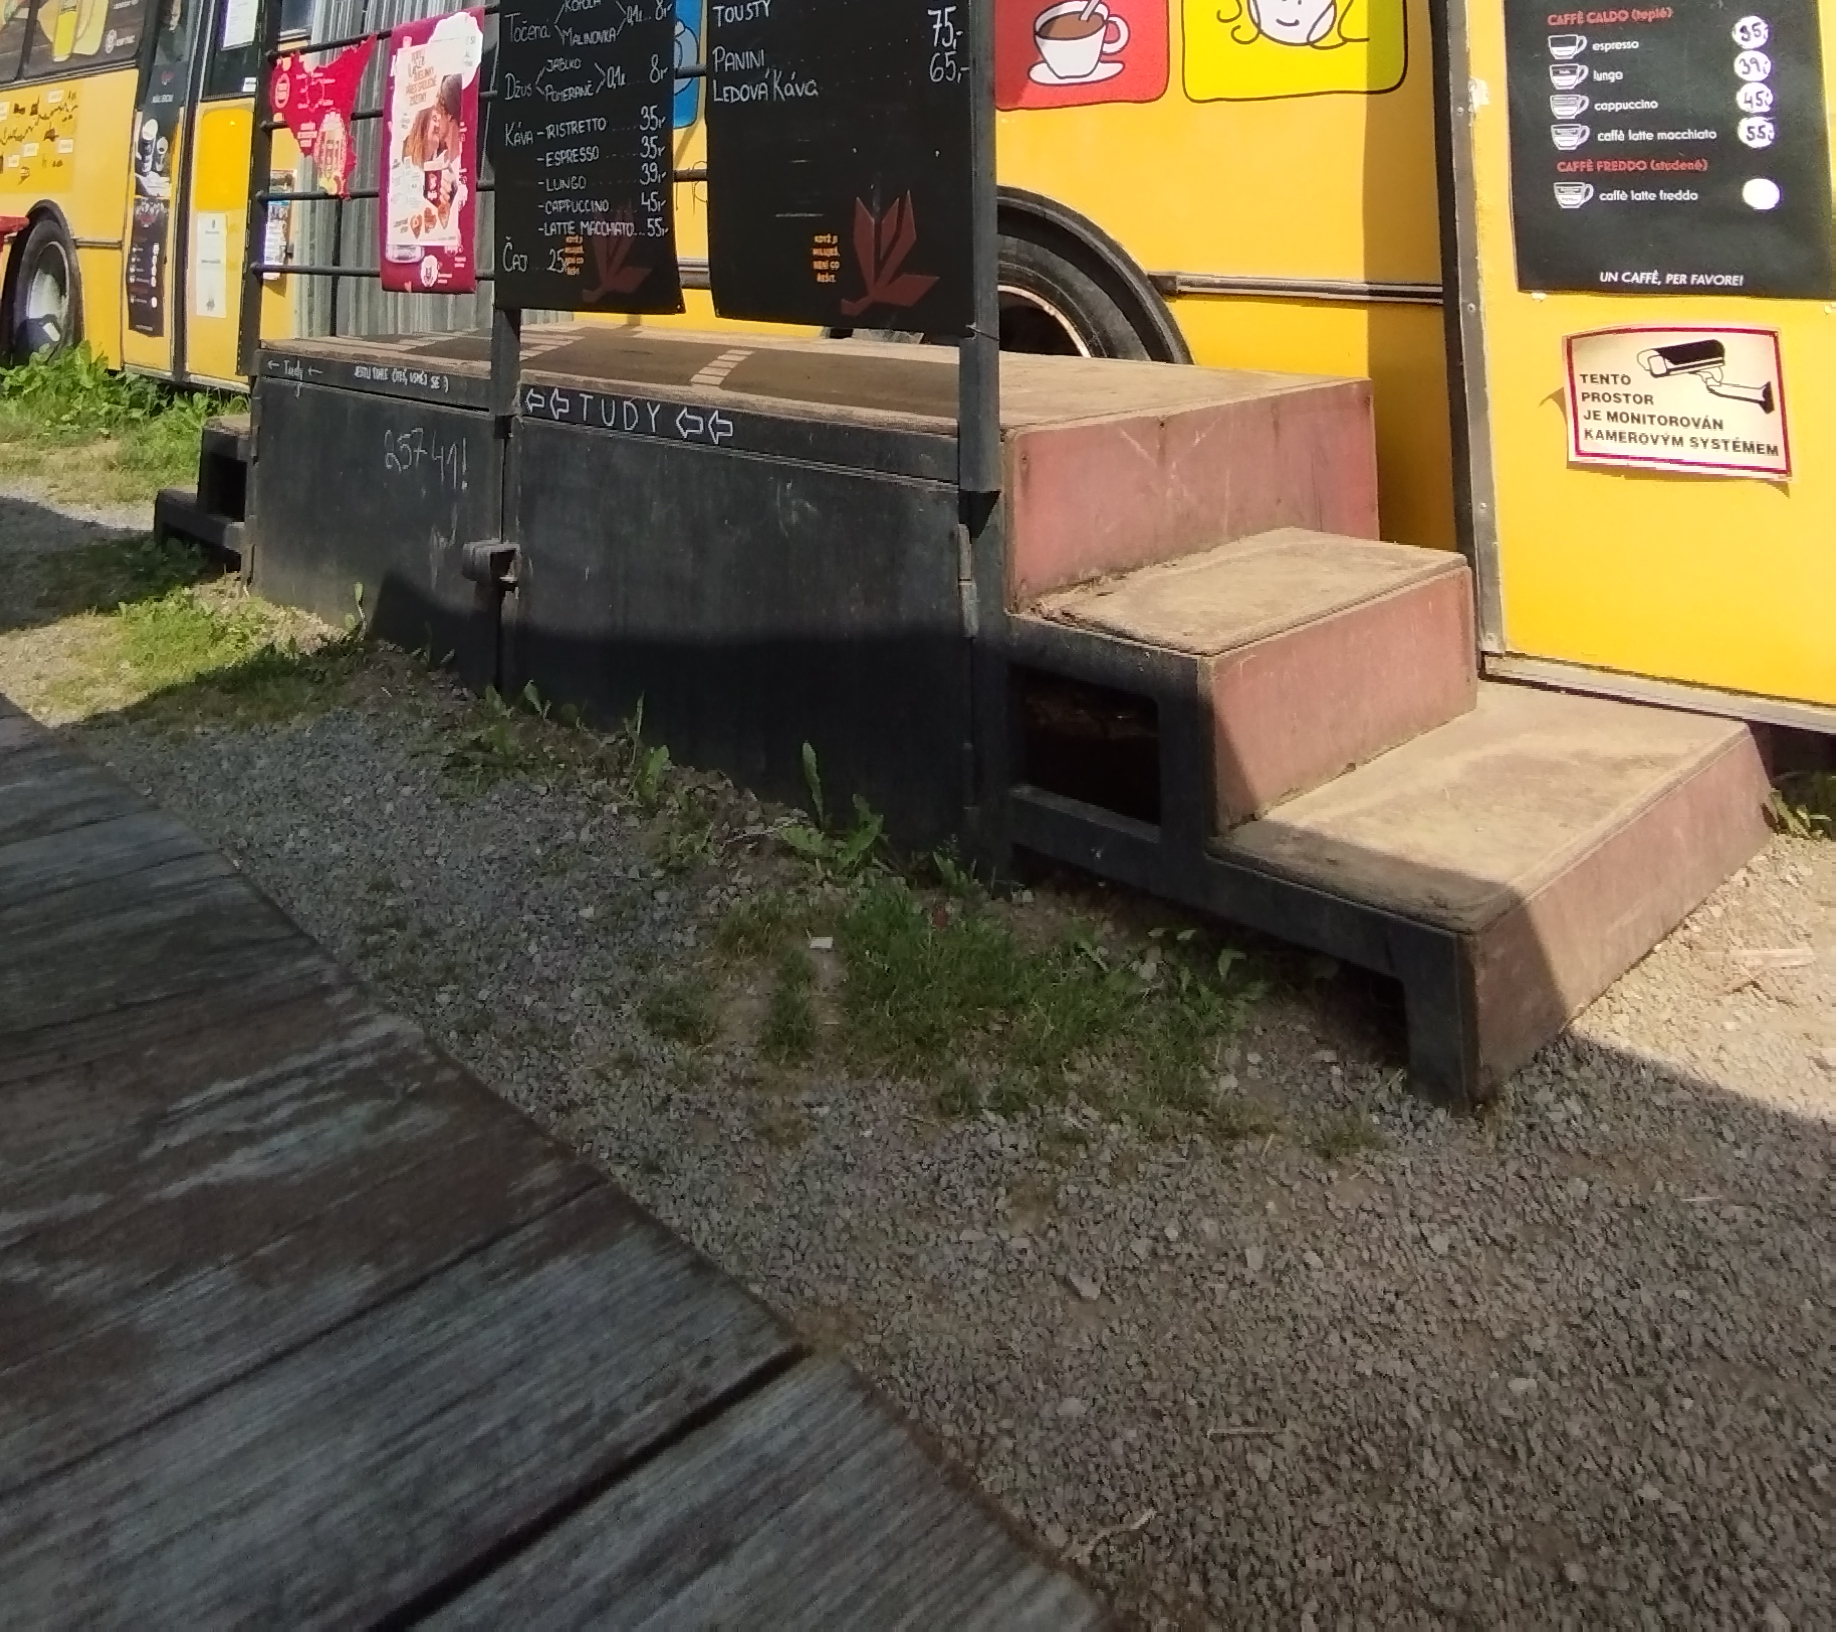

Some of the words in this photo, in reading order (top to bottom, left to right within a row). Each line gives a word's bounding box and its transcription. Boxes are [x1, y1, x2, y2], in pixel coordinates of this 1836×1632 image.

[1547, 11, 1585, 26] CAFFÈ
[1586, 9, 1628, 25] CALDO
[561, 26, 618, 46] MALINOVKA
[1592, 39, 1640, 52] espresso
[712, 46, 765, 72] PANINI
[1593, 70, 1624, 83] lungo
[545, 80, 594, 102] POMERANČ
[713, 68, 769, 103] LEDOVÁ
[1594, 99, 1659, 113] cappuccino
[1597, 129, 1625, 142] caffè
[1628, 129, 1654, 141] latte
[1657, 128, 1717, 141] macchiato
[1556, 158, 1594, 173] CAFFÈ
[1596, 160, 1647, 172] FREDDO
[1599, 189, 1628, 202] caffè
[1630, 189, 1657, 201] latte
[1659, 189, 1698, 202] freddo
[580, 221, 635, 237] MACCHIATO
[1599, 271, 1619, 283] UN
[1621, 269, 1662, 286] CAFFÈ,
[1665, 273, 1687, 286] PER
[1689, 272, 1744, 287] FAVORE!
[1579, 373, 1631, 386] TENTO
[1581, 392, 1654, 405] PROSTOR
[579, 394, 661, 433] TUDY
[1584, 410, 1602, 421] JE
[1607, 410, 1724, 431] MONITOROVÁN
[1584, 428, 1684, 447] KAMEROVÝM
[1690, 436, 1779, 457] SYSTÉMEM
